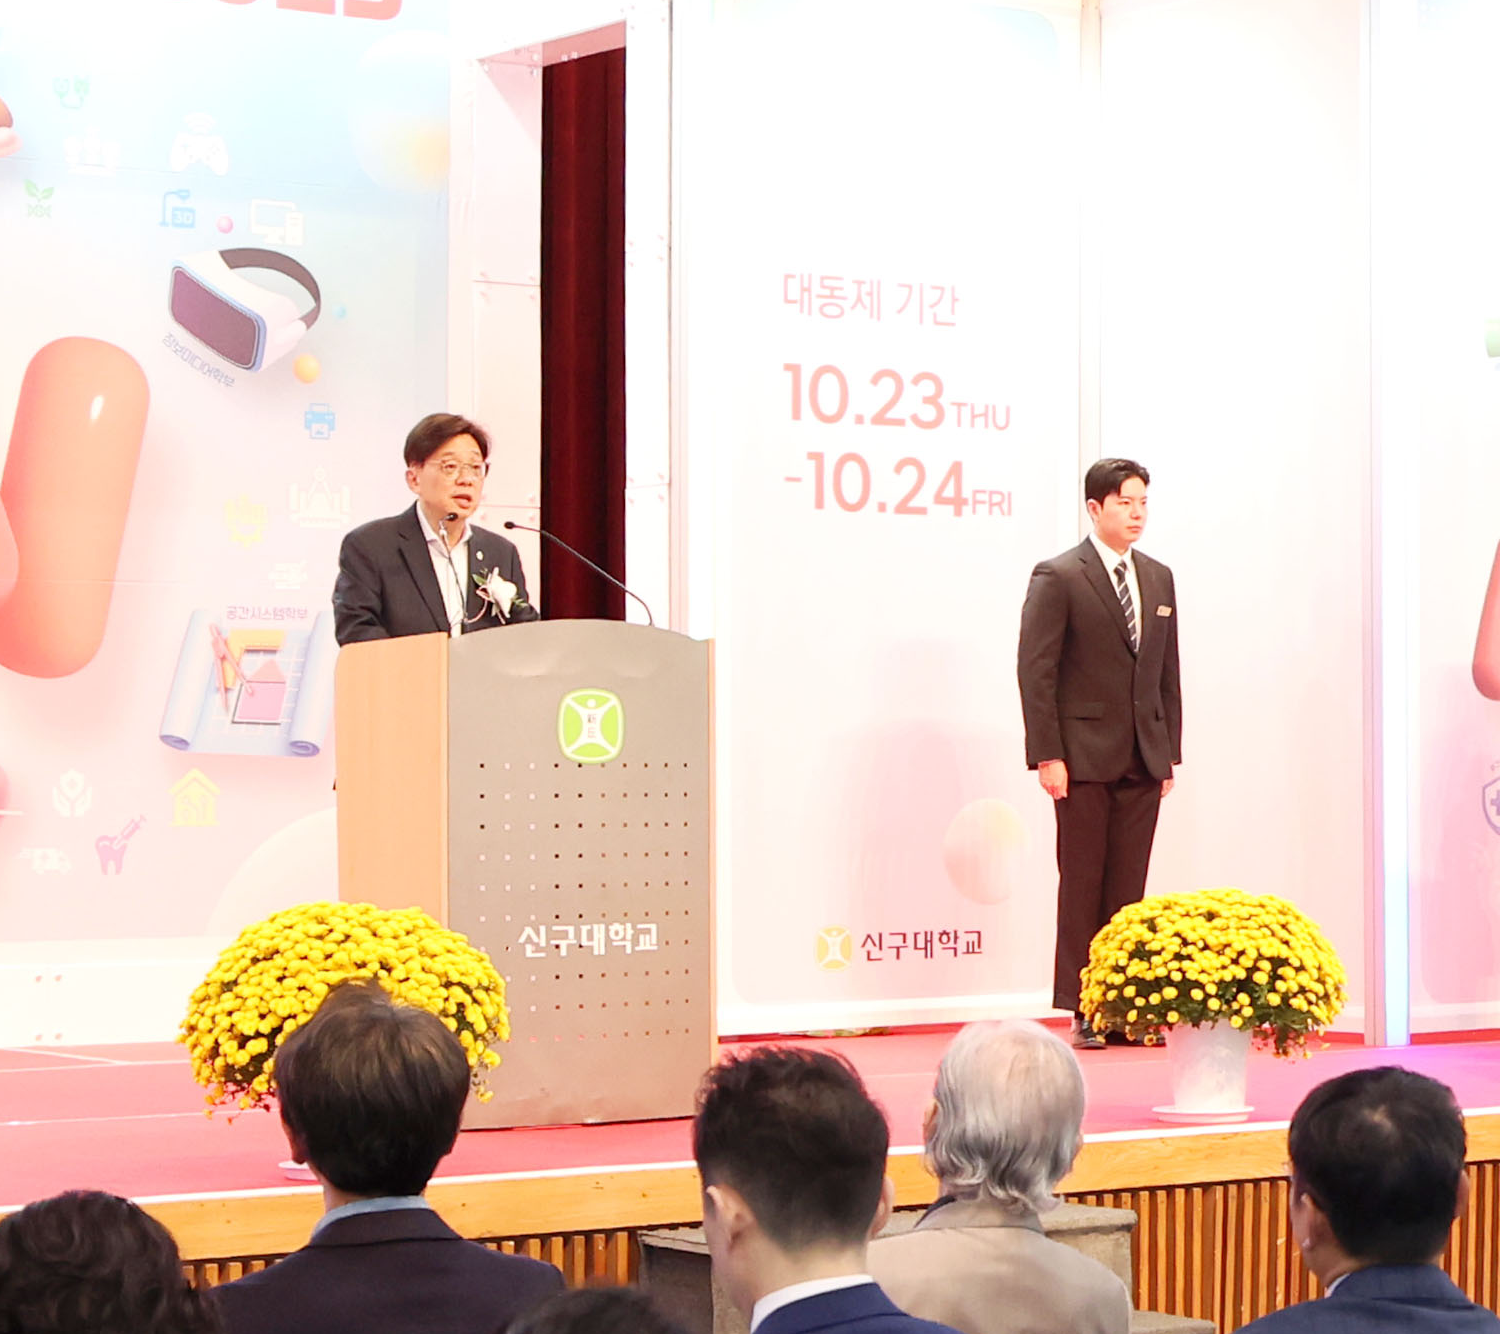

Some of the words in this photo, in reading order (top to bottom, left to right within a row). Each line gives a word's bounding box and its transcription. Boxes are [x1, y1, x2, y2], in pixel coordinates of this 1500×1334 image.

[783, 272, 882, 322] 대동제
[896, 282, 960, 327] 기간
[518, 922, 659, 959] 신구대학교
[860, 929, 984, 962] 신구대학교
